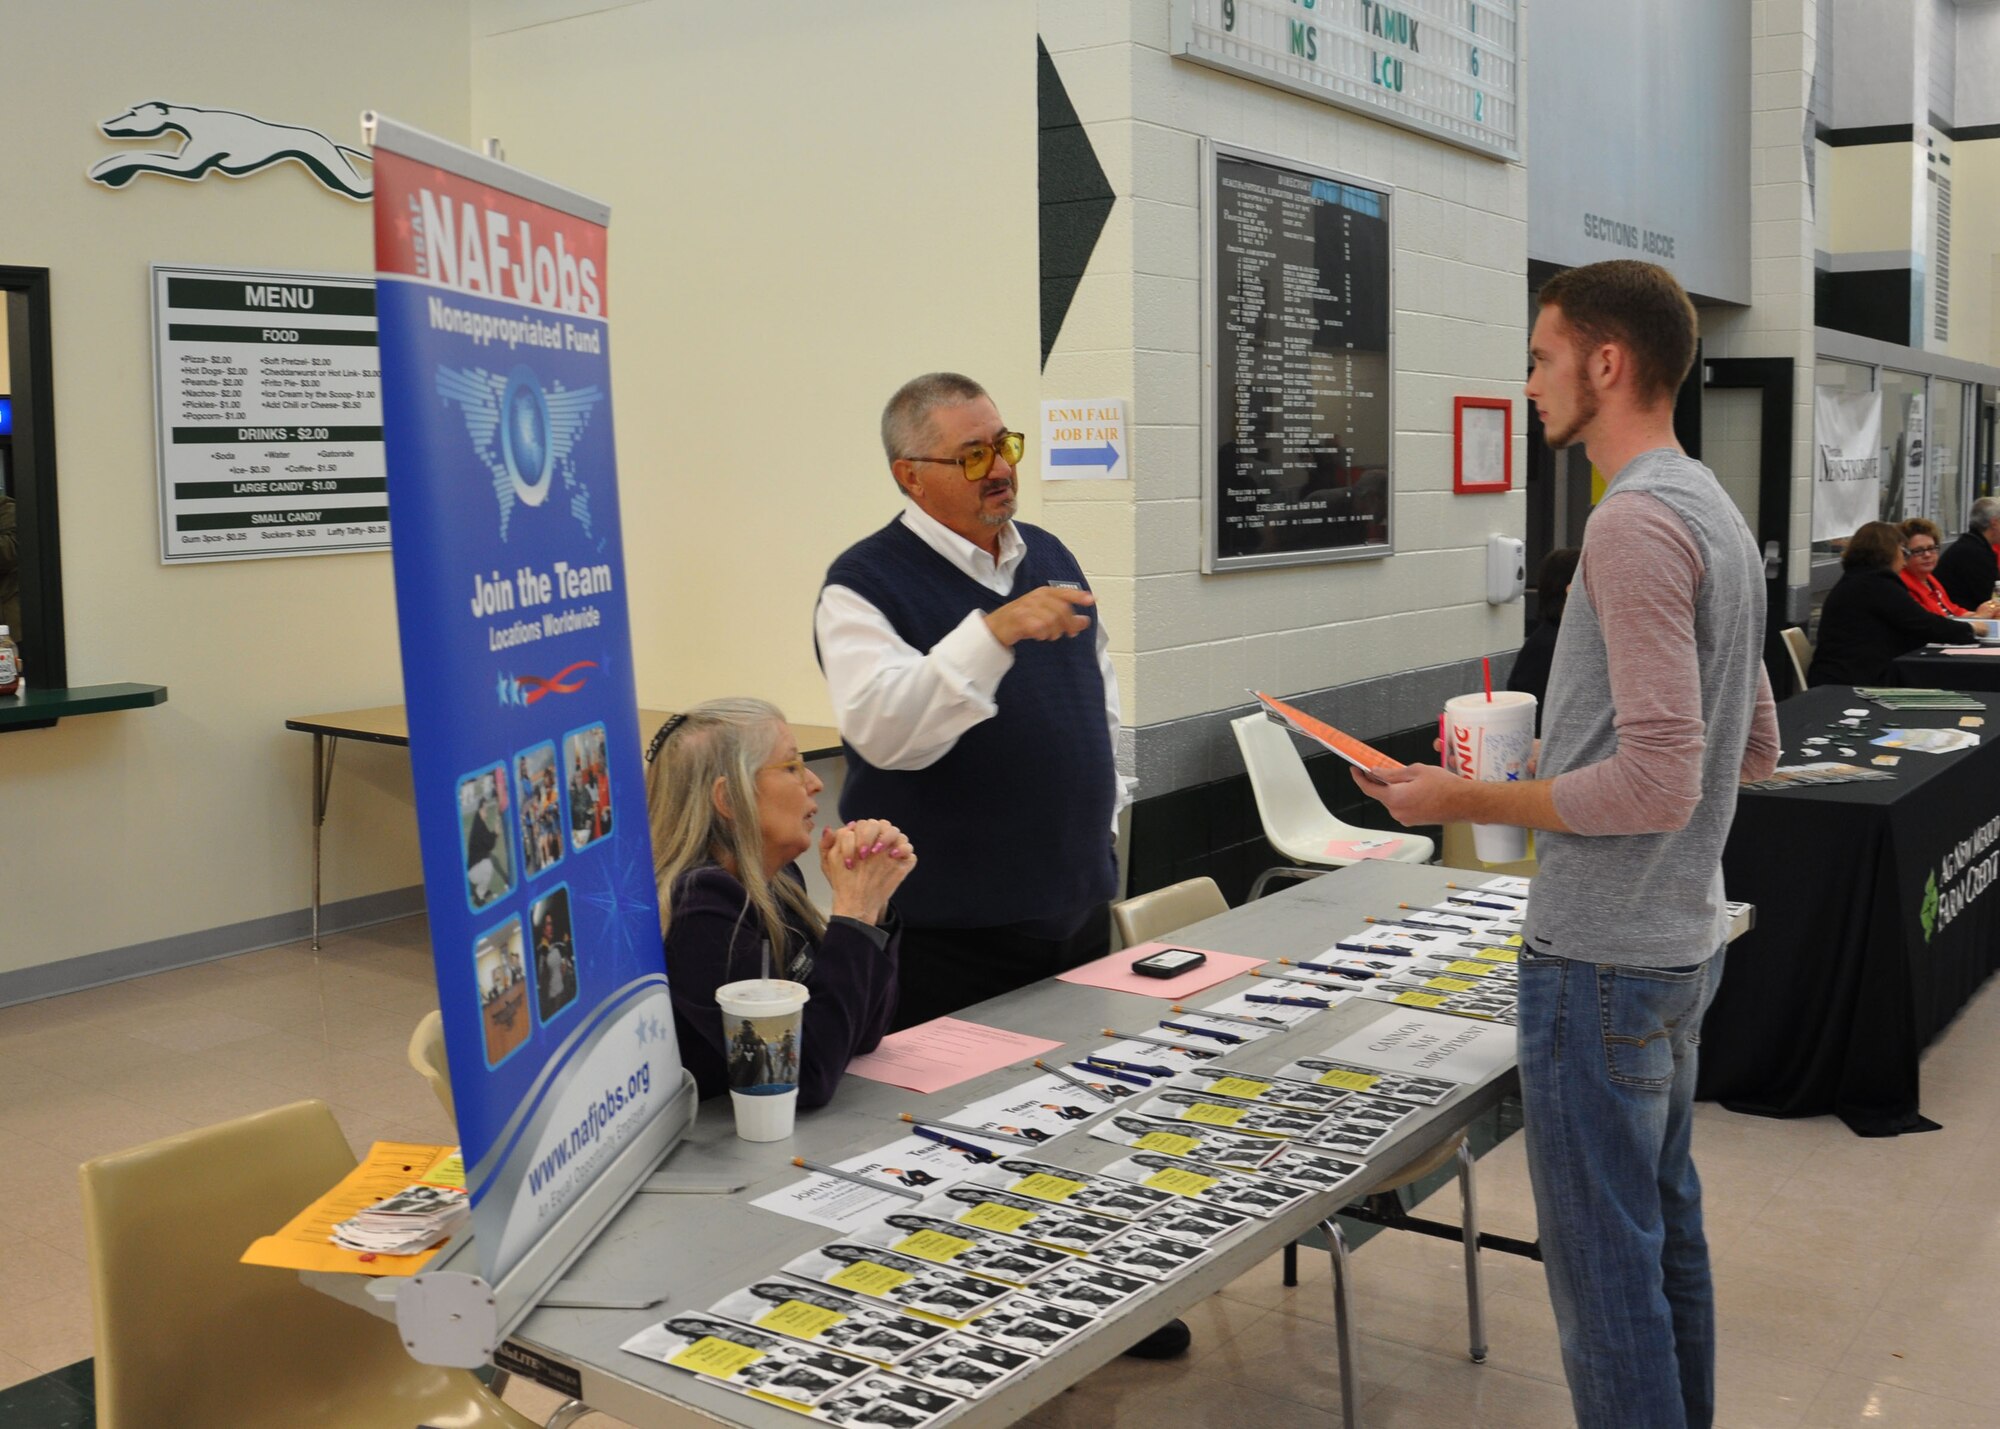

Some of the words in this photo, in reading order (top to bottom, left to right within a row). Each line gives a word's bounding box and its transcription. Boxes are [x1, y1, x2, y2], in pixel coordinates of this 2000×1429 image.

[1362, 0, 1419, 53] TAMUK
[1471, 47, 1479, 77] 6
[1224, 0, 1235, 32] 9
[1291, 19, 1317, 61] MS
[1373, 51, 1403, 92] LCU
[1583, 213, 1638, 249] SECTIONS
[1642, 230, 1675, 259] ABCDE
[245, 285, 314, 309] MENU
[428, 296, 562, 350] Nonappropriated
[565, 323, 601, 354] Fund
[262, 329, 299, 342] FOOD
[211, 356, 232, 364] $2.00
[312, 358, 332, 366] $2.00
[227, 367, 248, 375] $2.00
[328, 369, 341, 377] Hot
[223, 378, 244, 386] $2.00
[221, 389, 242, 398] $2.00
[279, 390, 303, 398] Cream
[304, 391, 313, 399] by
[316, 390, 327, 398] the
[356, 390, 376, 398] $1.00
[220, 400, 241, 408] $1.00
[342, 400, 362, 408] $0.50
[225, 412, 246, 420] $1.00
[1048, 408, 1082, 422] ENM
[1087, 408, 1120, 421] FALL
[238, 428, 288, 440] DRINKS
[297, 428, 329, 440] $2.00
[1052, 428, 1082, 441] JOB
[1086, 427, 1119, 440] FAIR
[215, 452, 236, 460] Soda
[268, 450, 290, 458] Water
[320, 450, 354, 458] Gatorade
[250, 466, 271, 474] $0.50
[318, 464, 337, 472] $1.50
[232, 483, 268, 493] LARGE
[269, 481, 305, 492] CANDY
[312, 480, 338, 490] $1.00
[252, 513, 285, 524] SMALL
[287, 512, 322, 522] CANDY
[296, 529, 316, 538] $0.50
[327, 527, 346, 536] Laffy
[368, 526, 386, 534] $0.25
[182, 535, 201, 544] Gum
[226, 532, 247, 542] $0.25
[471, 570, 515, 618] Join
[516, 566, 552, 608] the
[554, 561, 613, 600] Team
[489, 620, 542, 652] Locations
[542, 605, 601, 638] Worldwide
[1454, 725, 1474, 780] NIC
[1938, 879, 1965, 933] FARM
[1966, 849, 2000, 904] CREDIT
[1368, 1022, 1425, 1052] CANNON
[1407, 1034, 1440, 1050] NAF
[1414, 1025, 1488, 1069] EMPLOYMENT
[1001, 1100, 1041, 1114] Team
[528, 1062, 650, 1196] www.nafjobs.org
[906, 1142, 945, 1157] Team
[791, 1183, 819, 1202] Join
[819, 1177, 847, 1191] the
[851, 1163, 883, 1177] eam
